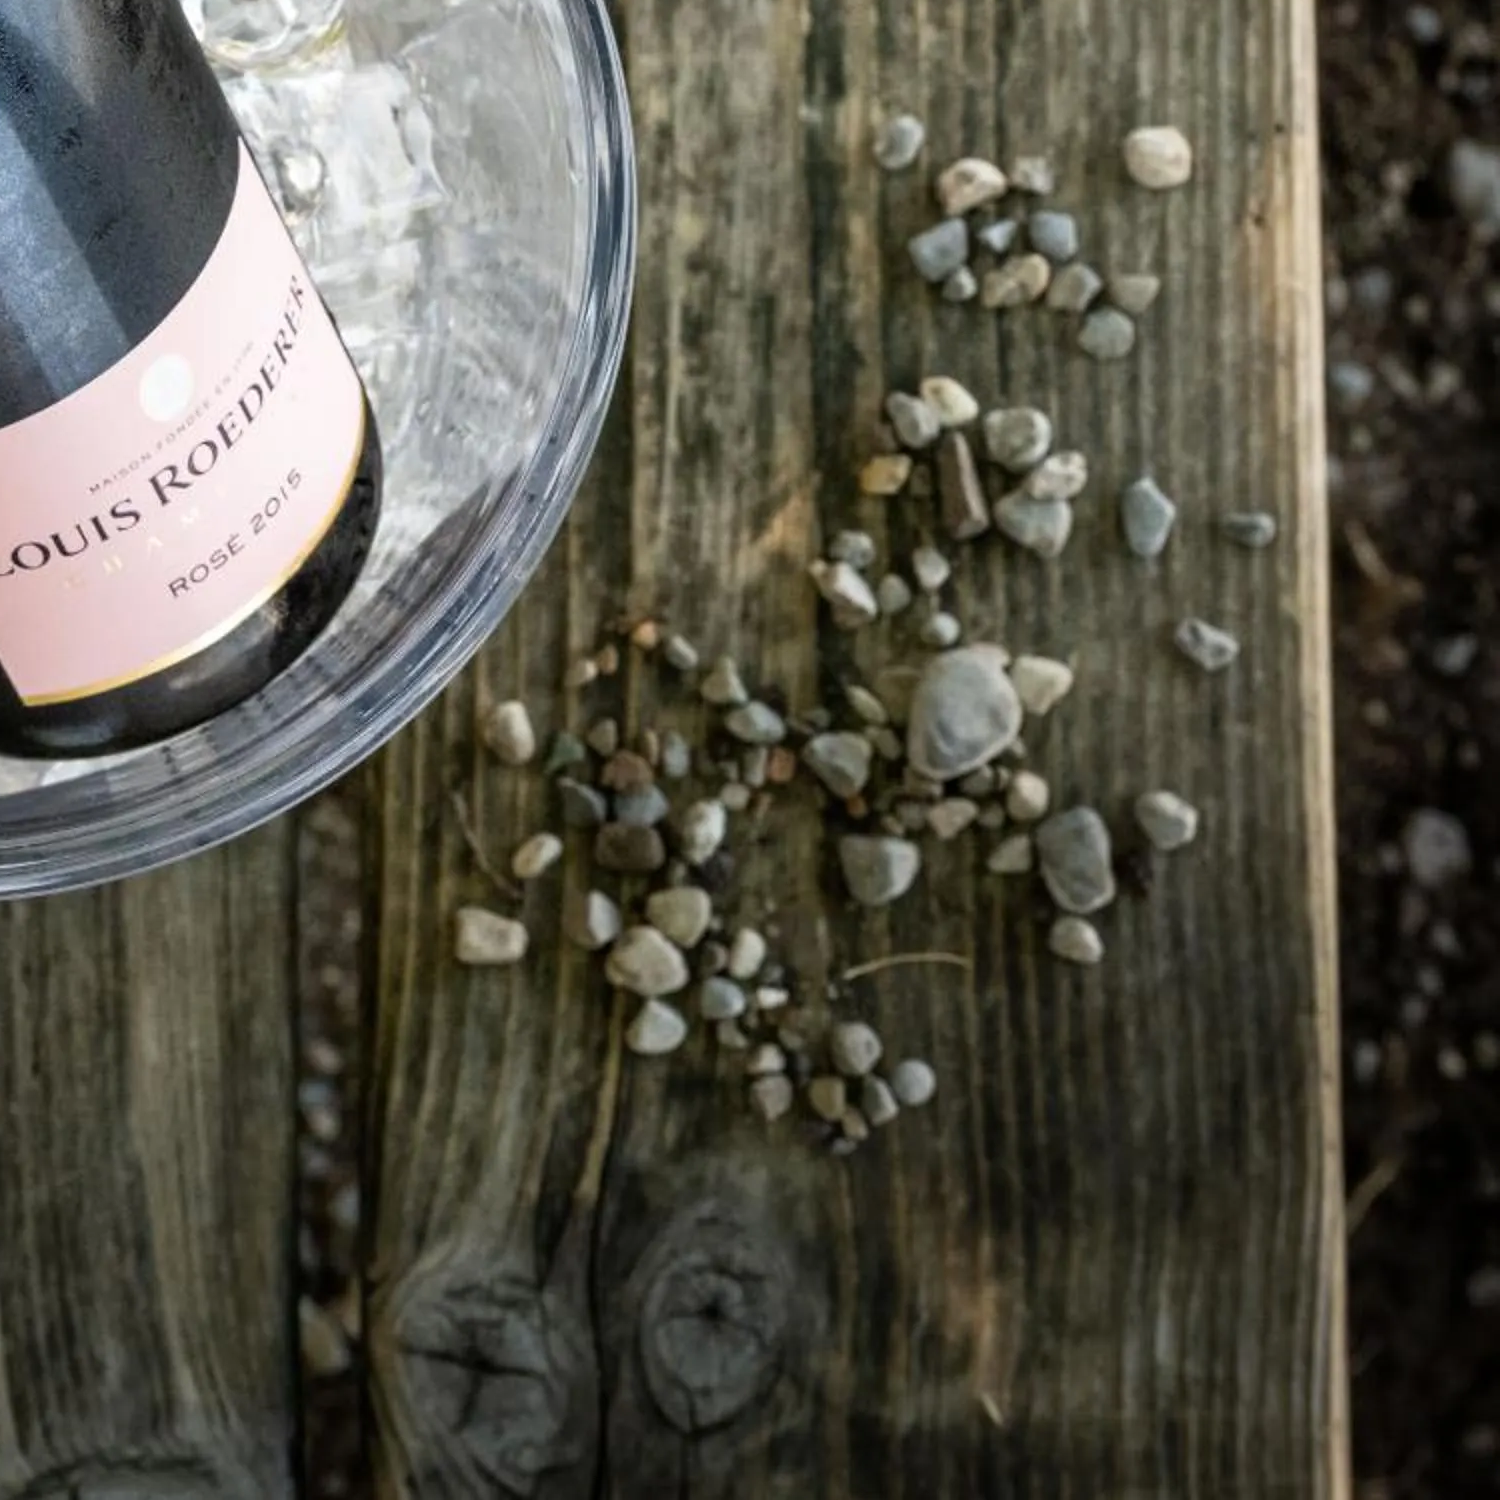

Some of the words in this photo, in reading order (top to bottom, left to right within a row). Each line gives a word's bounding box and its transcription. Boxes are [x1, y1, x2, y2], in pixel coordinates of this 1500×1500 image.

[149, 275, 304, 507] ROEDERER
[88, 452, 152, 494] MAISON
[168, 533, 244, 598] ROSÉ
[250, 467, 302, 535] 2015
